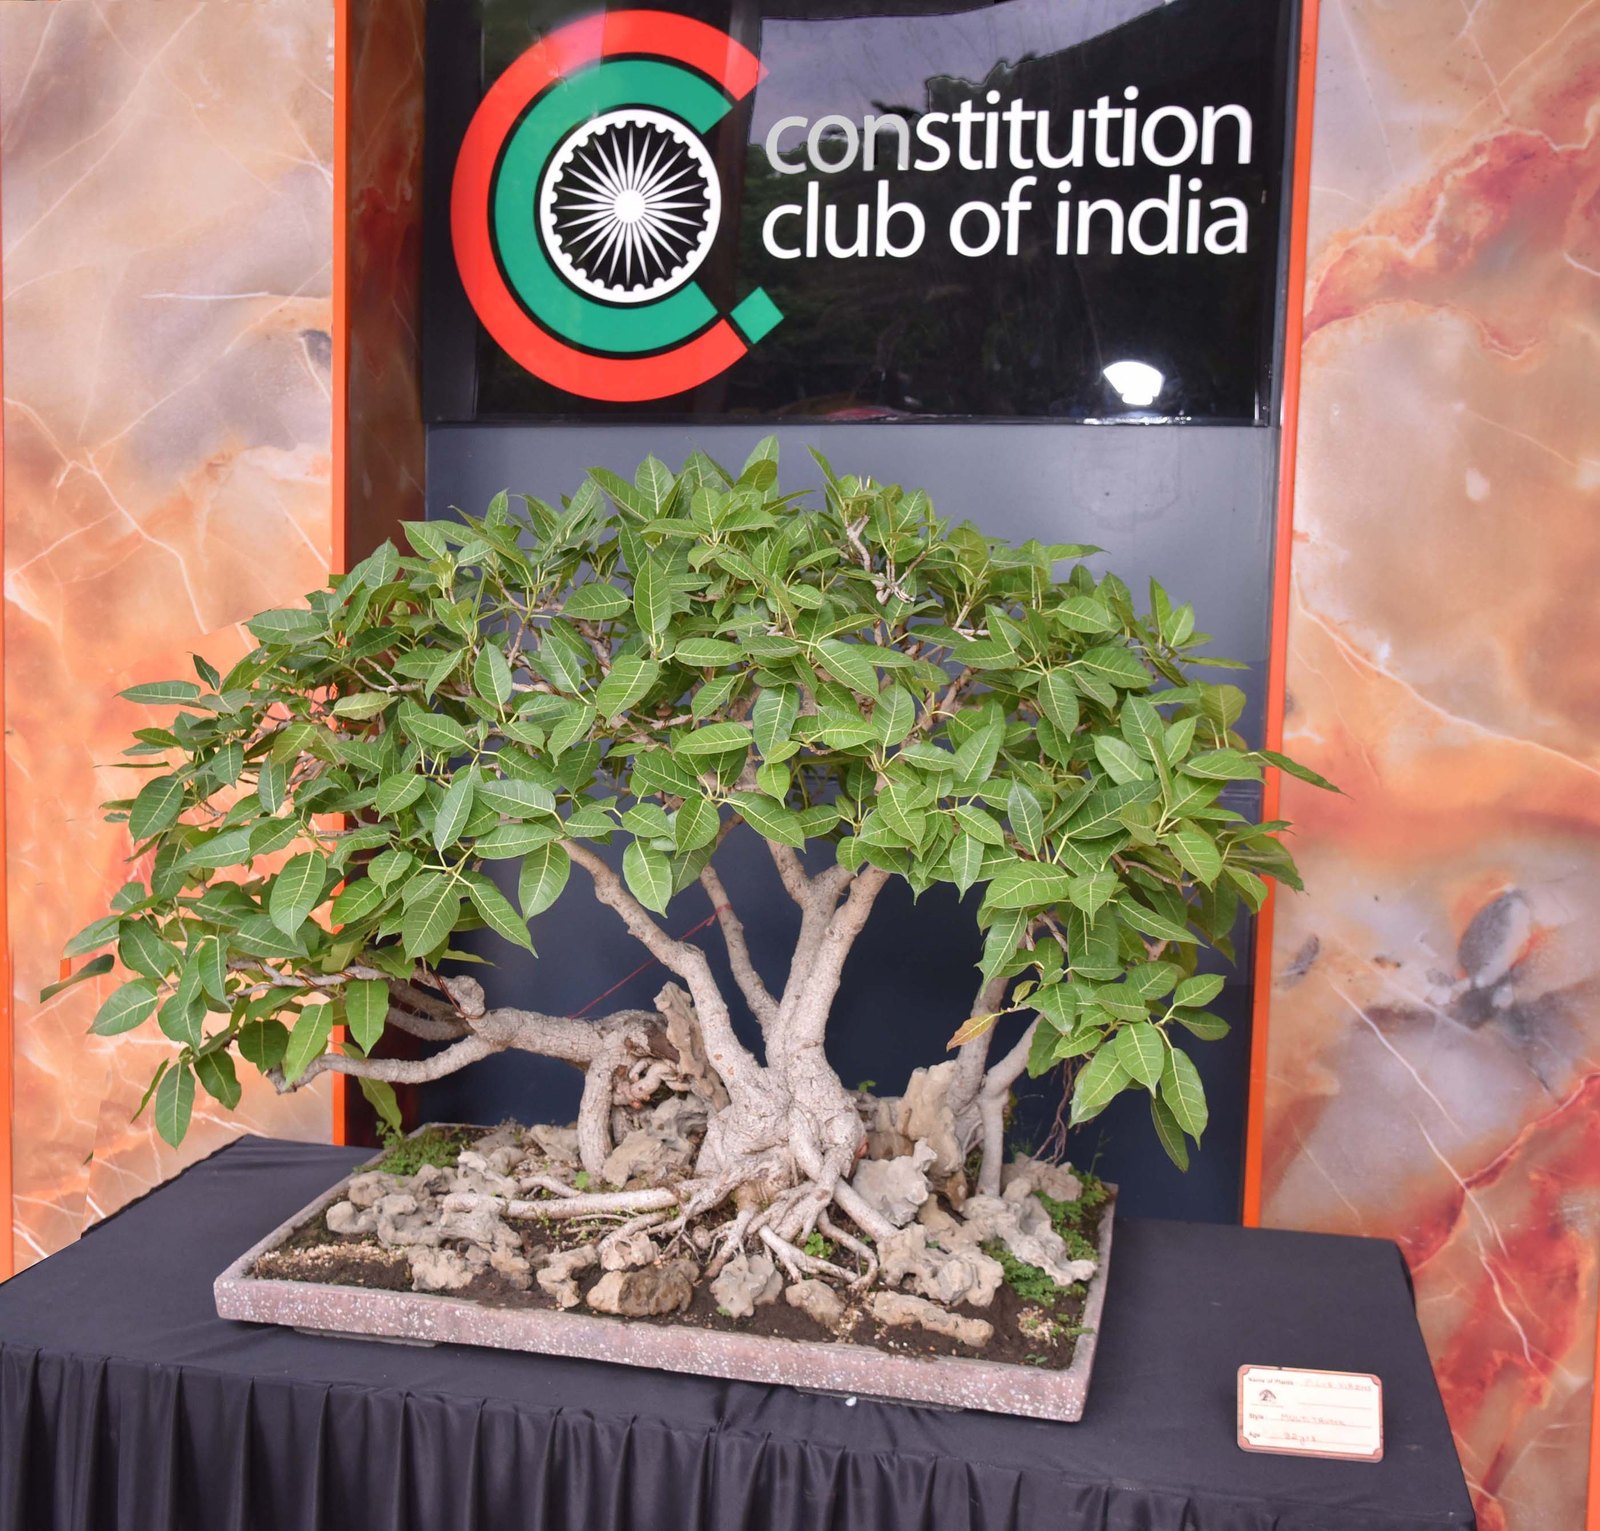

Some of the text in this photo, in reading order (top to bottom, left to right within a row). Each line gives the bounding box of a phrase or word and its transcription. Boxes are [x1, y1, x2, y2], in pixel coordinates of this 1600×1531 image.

[765, 86, 1252, 174] constitution
[762, 174, 1249, 259] club of india
